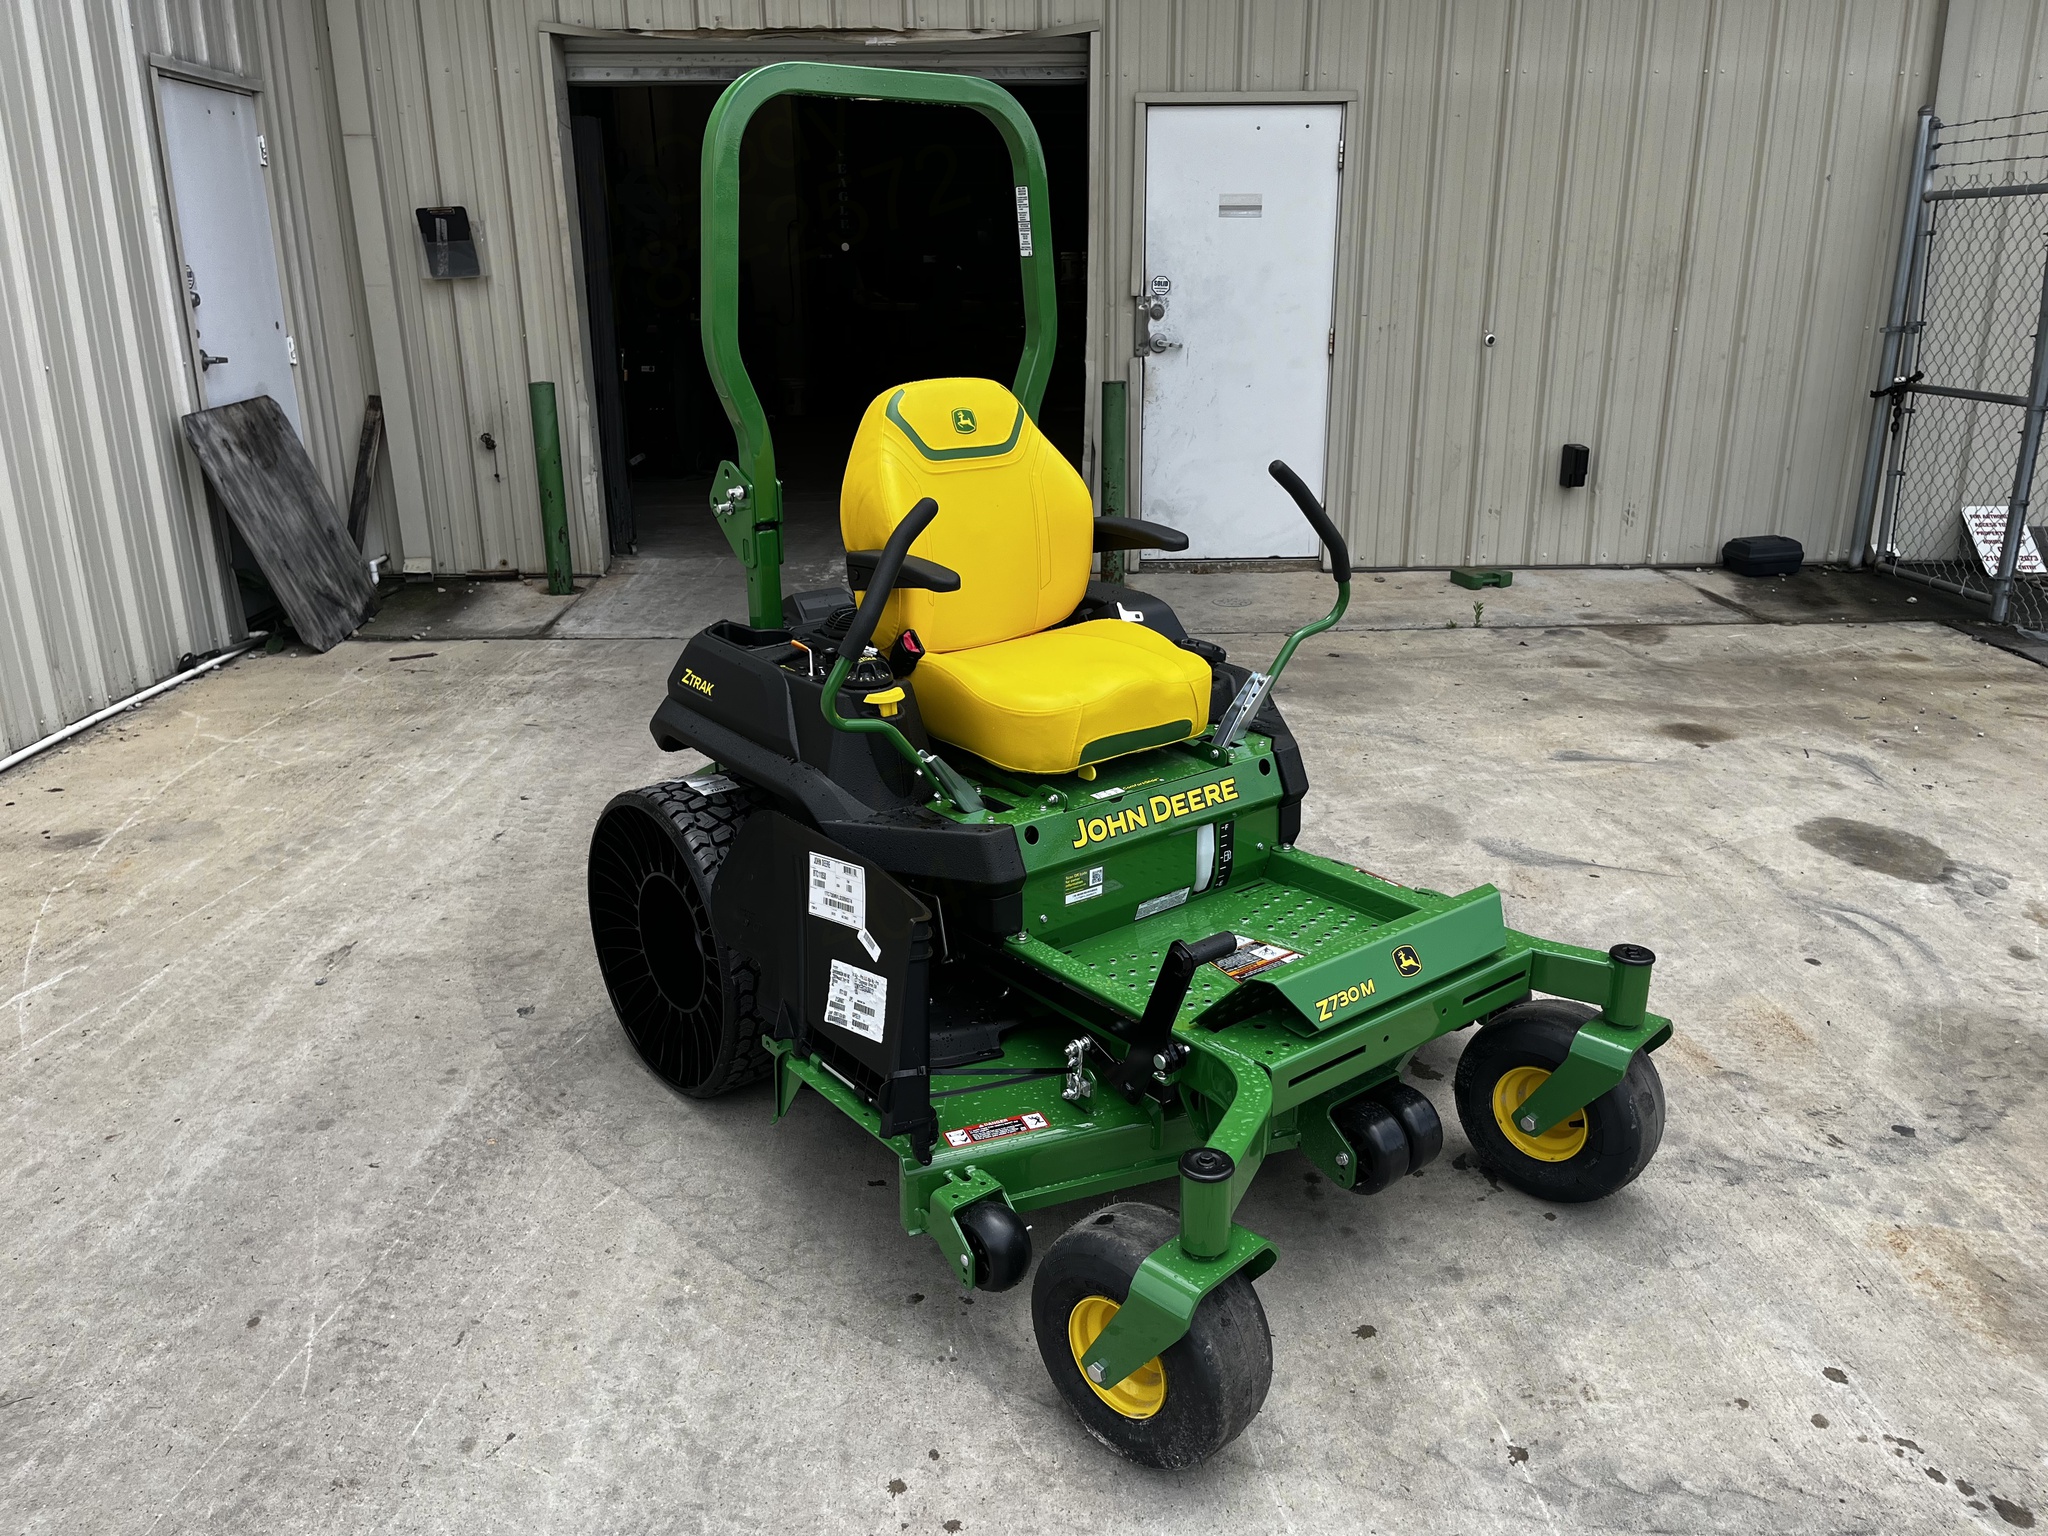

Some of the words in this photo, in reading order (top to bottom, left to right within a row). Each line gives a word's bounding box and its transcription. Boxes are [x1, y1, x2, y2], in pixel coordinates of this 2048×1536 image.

[681, 668, 715, 697] ZTRAK
[1073, 804, 1148, 849] JOHN
[1149, 777, 1239, 823] DEERE
